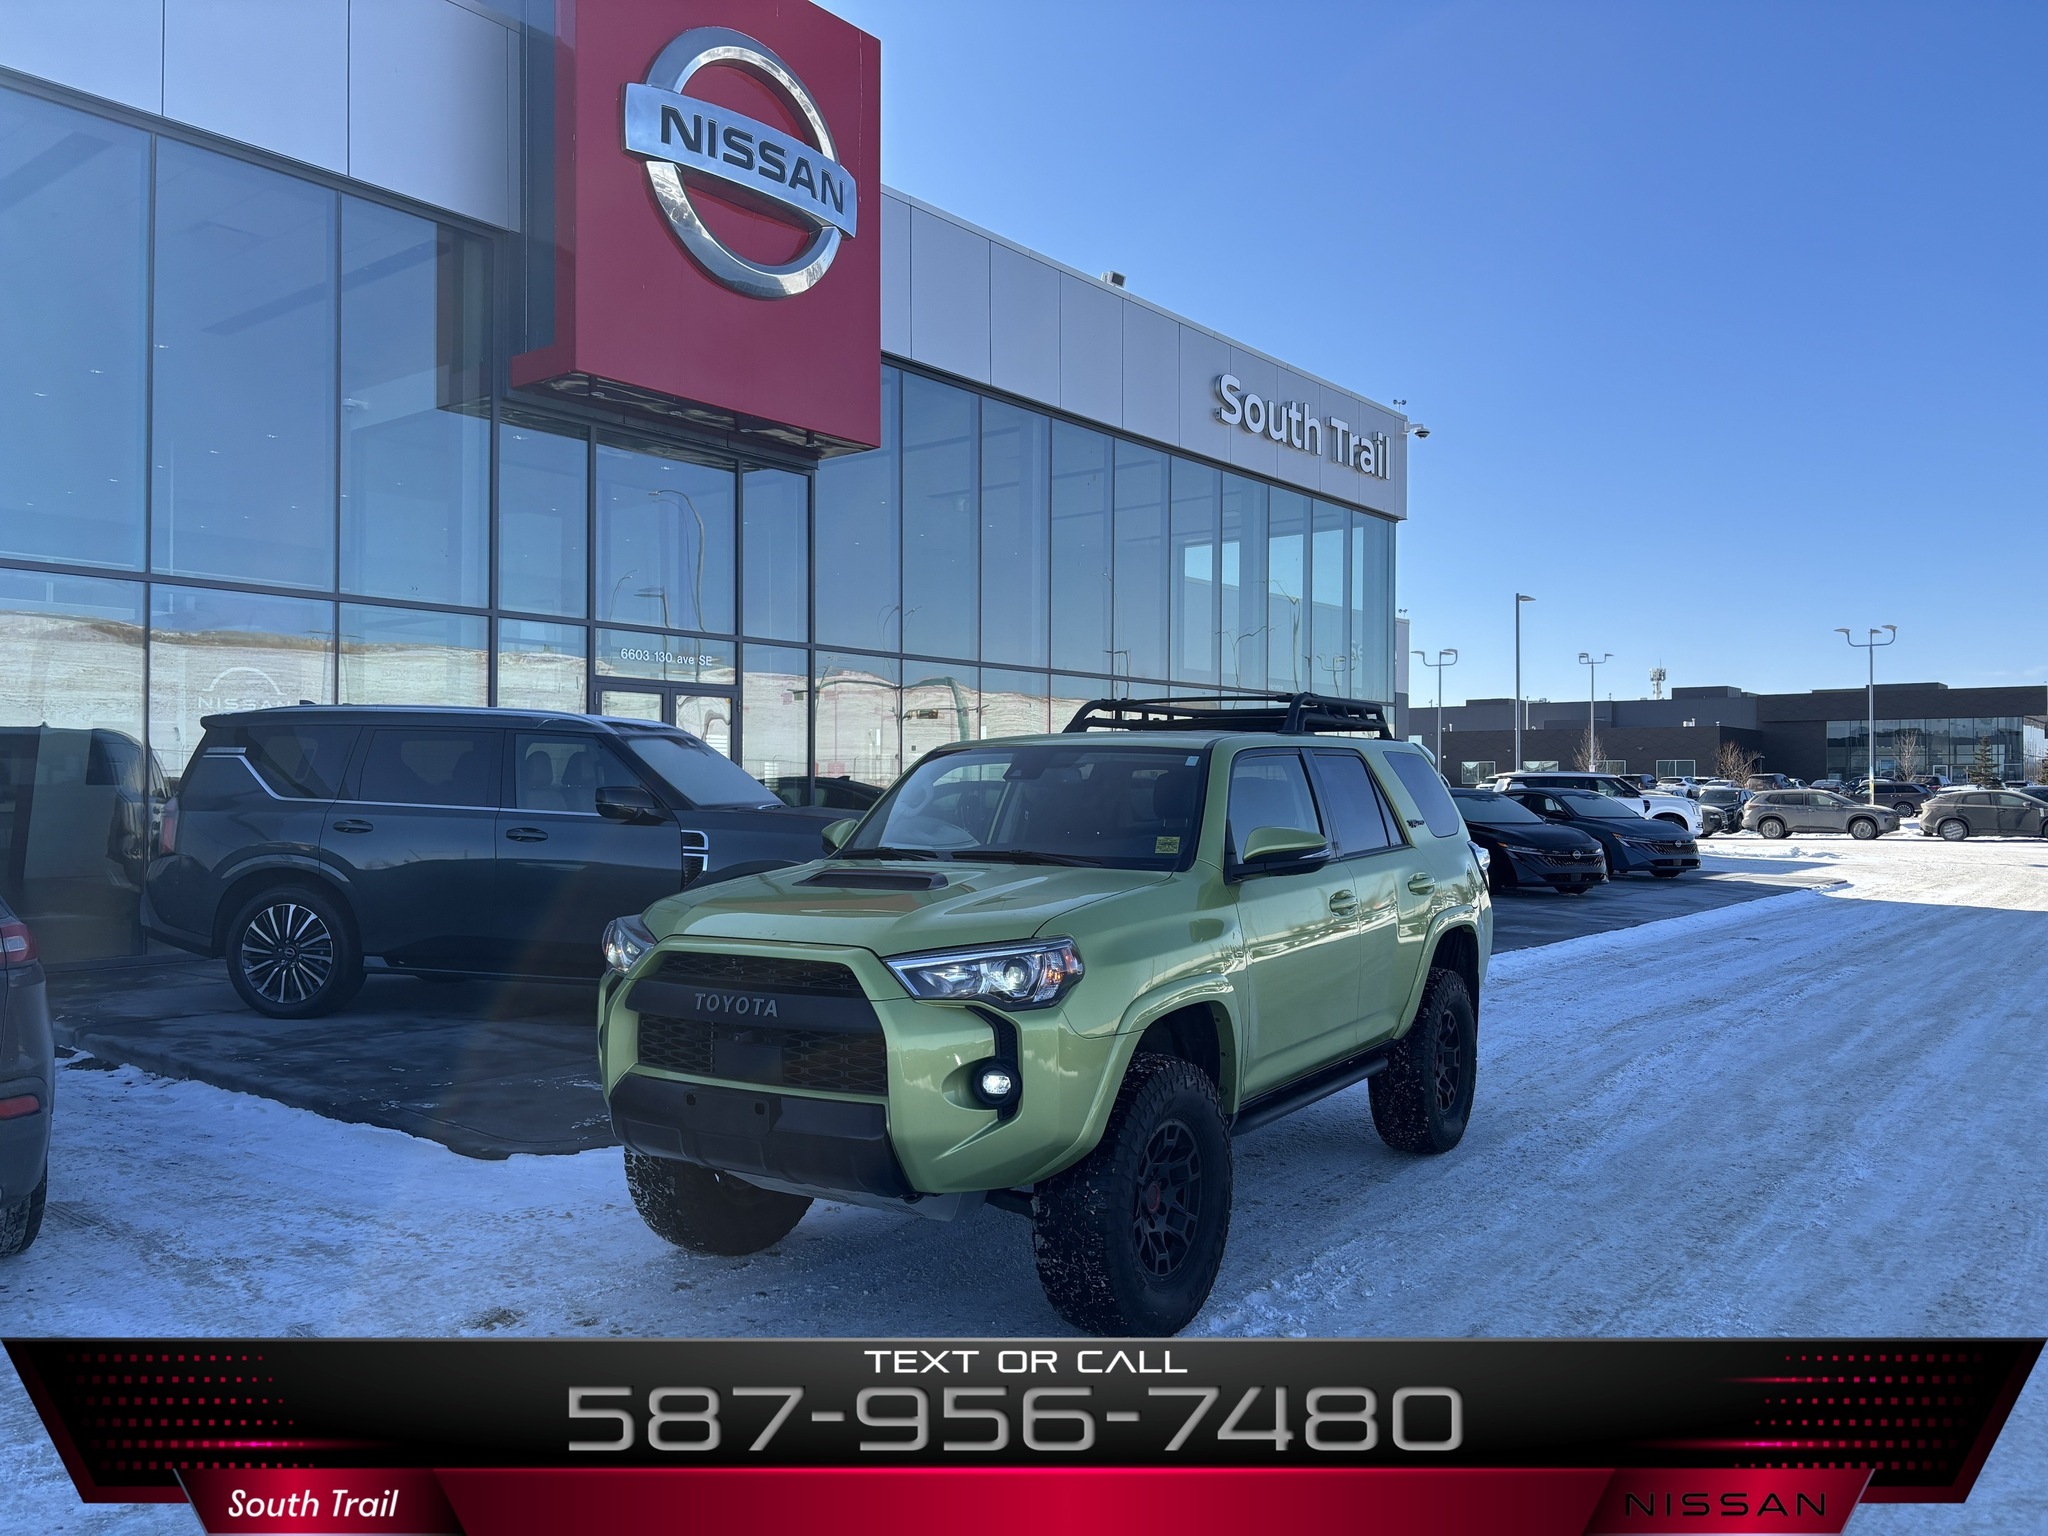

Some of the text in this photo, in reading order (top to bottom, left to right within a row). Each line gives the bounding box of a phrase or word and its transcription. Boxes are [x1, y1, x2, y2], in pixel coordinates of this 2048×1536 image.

[660, 103, 845, 216] NISSAN
[1215, 373, 1391, 481] South Trail
[620, 647, 713, 666] 6603 130 ave SE
[694, 992, 778, 1018] TOYOTA
